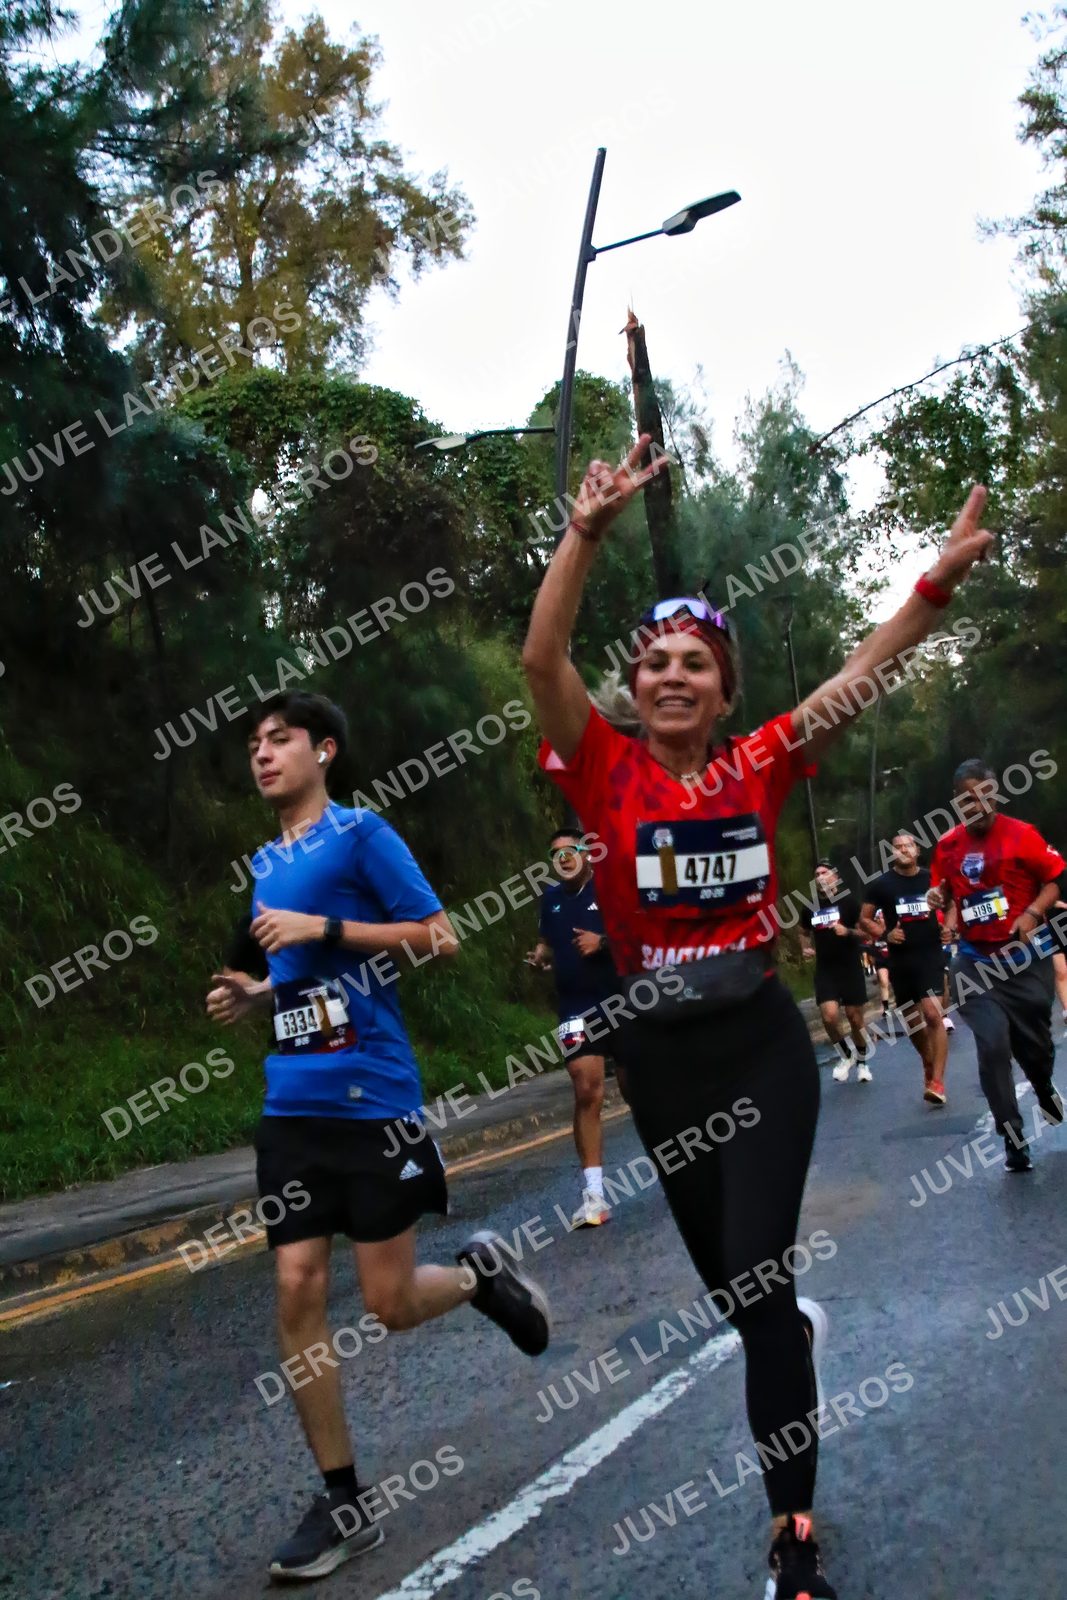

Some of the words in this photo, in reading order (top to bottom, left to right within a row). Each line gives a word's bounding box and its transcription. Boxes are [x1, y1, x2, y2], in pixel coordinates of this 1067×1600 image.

[684, 854, 737, 885] 4747
[971, 903, 994, 918] 5196
[281, 1007, 317, 1037] 5334
